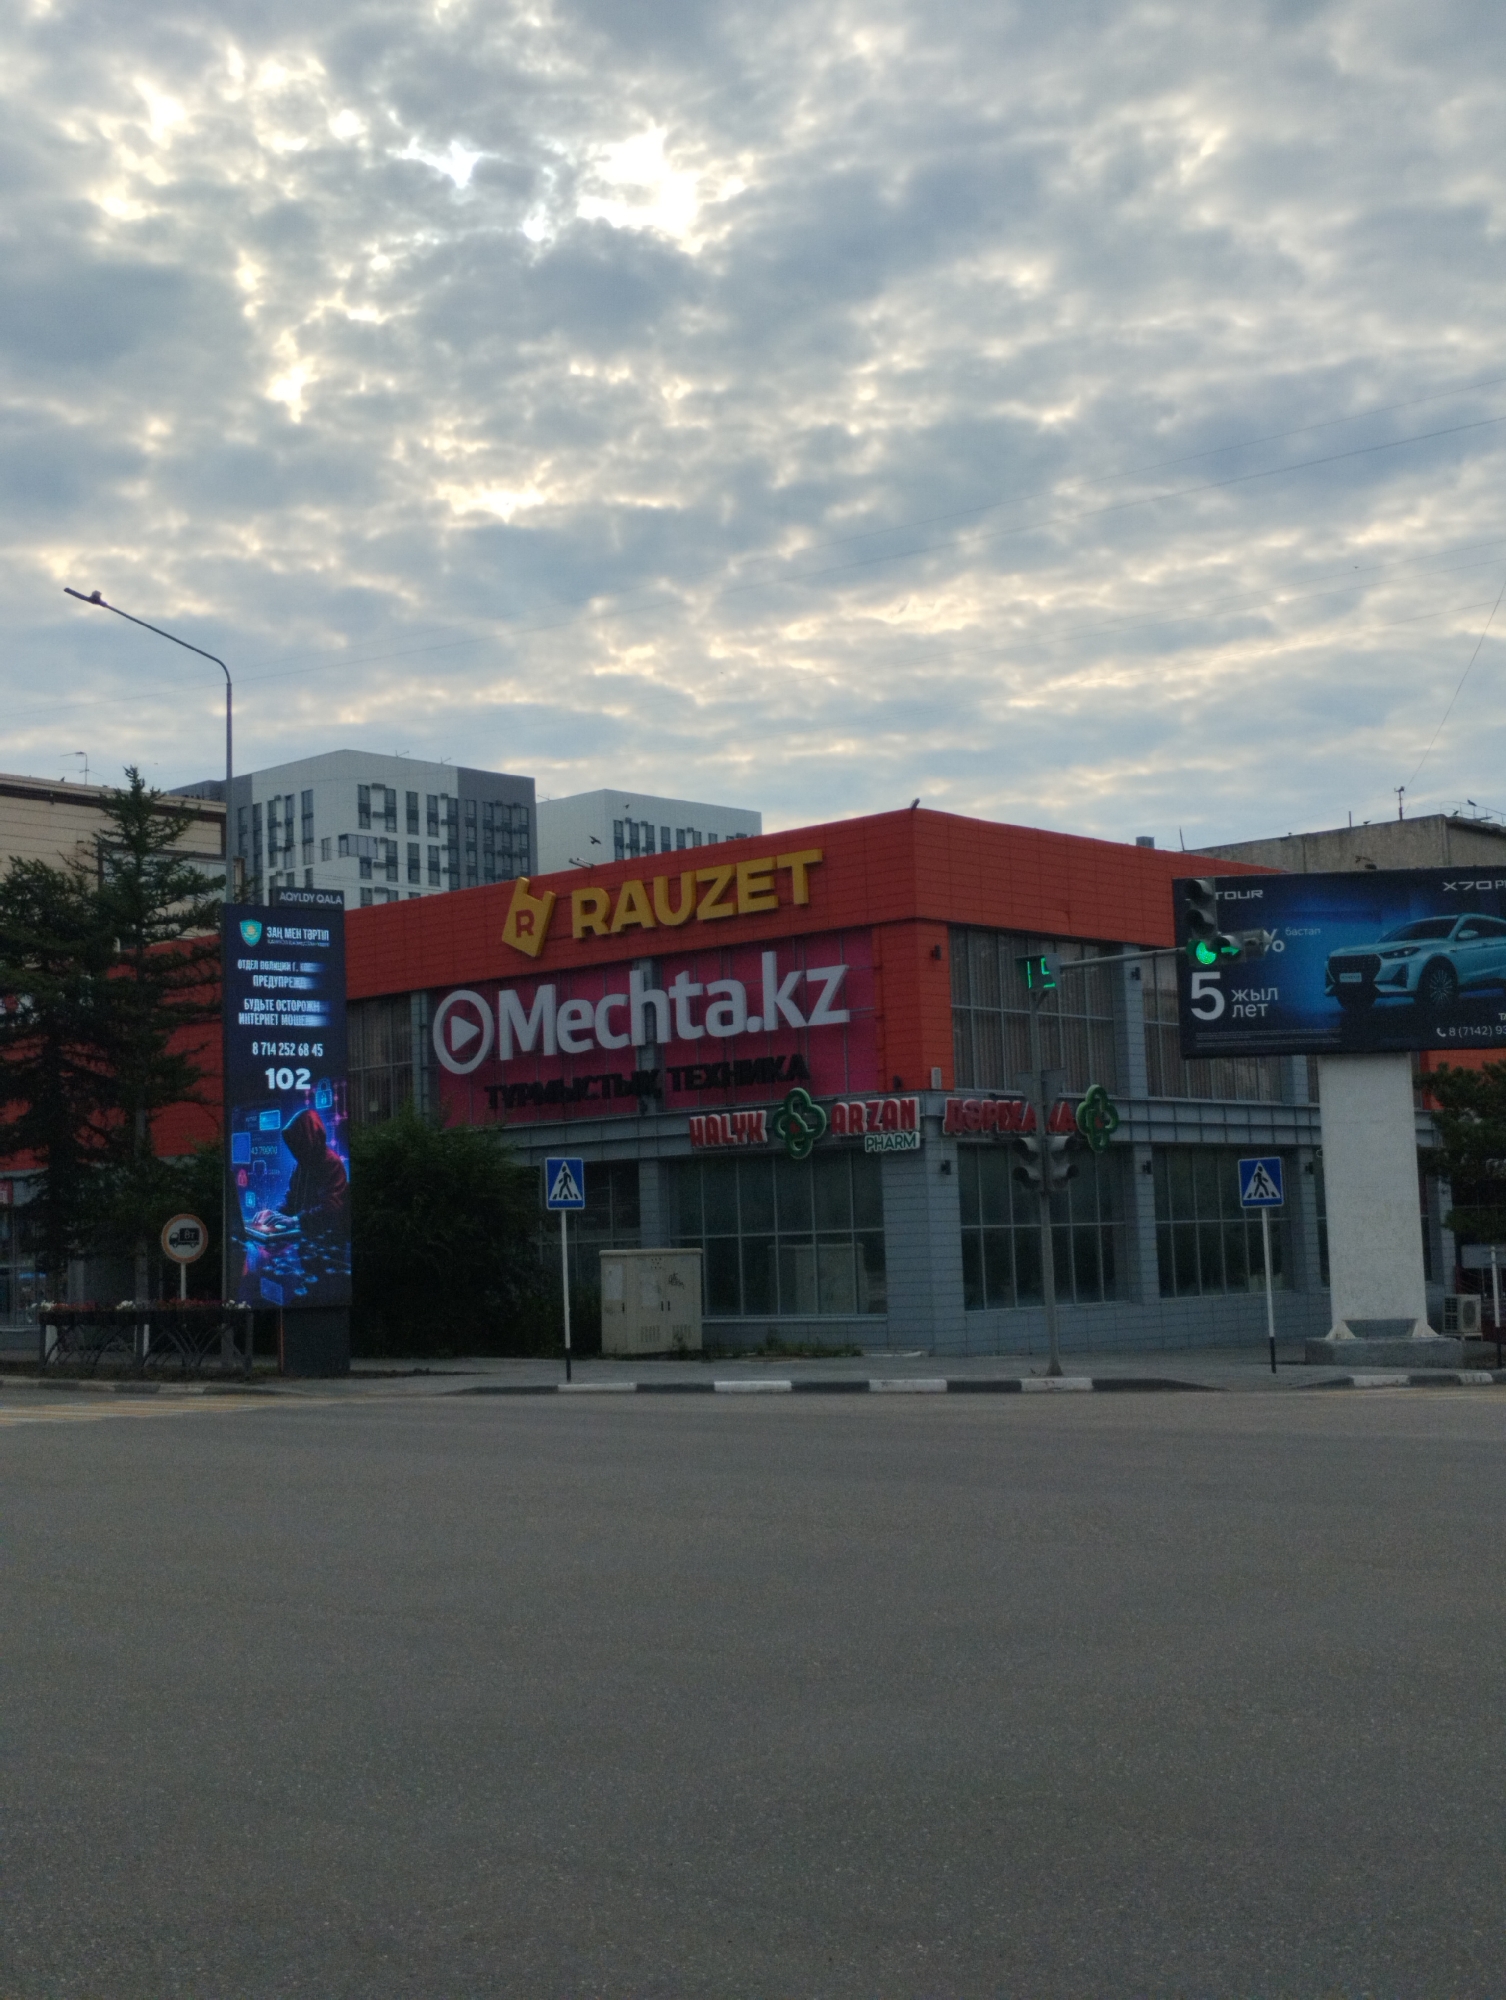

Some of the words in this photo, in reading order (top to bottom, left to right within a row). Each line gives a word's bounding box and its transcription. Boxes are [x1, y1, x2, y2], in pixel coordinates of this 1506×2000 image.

[1442, 880, 1493, 891] X70
[279, 891, 315, 903] AQYLDY
[316, 894, 343, 905] QALA
[571, 848, 823, 939] RAUZET
[515, 909, 534, 938] R
[1285, 926, 1321, 936] бастап
[266, 926, 283, 940] ЗАҢ
[284, 927, 302, 940] МЕН
[238, 959, 259, 971] ОТДЕЛ
[1191, 971, 1225, 1021] 5
[1231, 988, 1278, 1002] жыл
[244, 998, 275, 1012] БУДЬТЕ
[498, 951, 851, 1062] Mechta.kz
[1232, 1003, 1268, 1018] лет
[238, 1012, 279, 1026] ИНТЕРНЕТ
[1449, 1027, 1456, 1036] 8
[1458, 1025, 1493, 1038] (7142)
[252, 1041, 259, 1056] 8
[261, 1042, 277, 1056] 714
[278, 1042, 296, 1057] 252
[298, 1043, 310, 1057] 68
[311, 1043, 324, 1057] 45
[265, 1067, 311, 1090] 102
[666, 1054, 811, 1092] ТЕХНИКА
[689, 1109, 768, 1149] HALYK
[830, 1096, 920, 1138] ARZAN
[864, 1132, 920, 1152] PHARM
